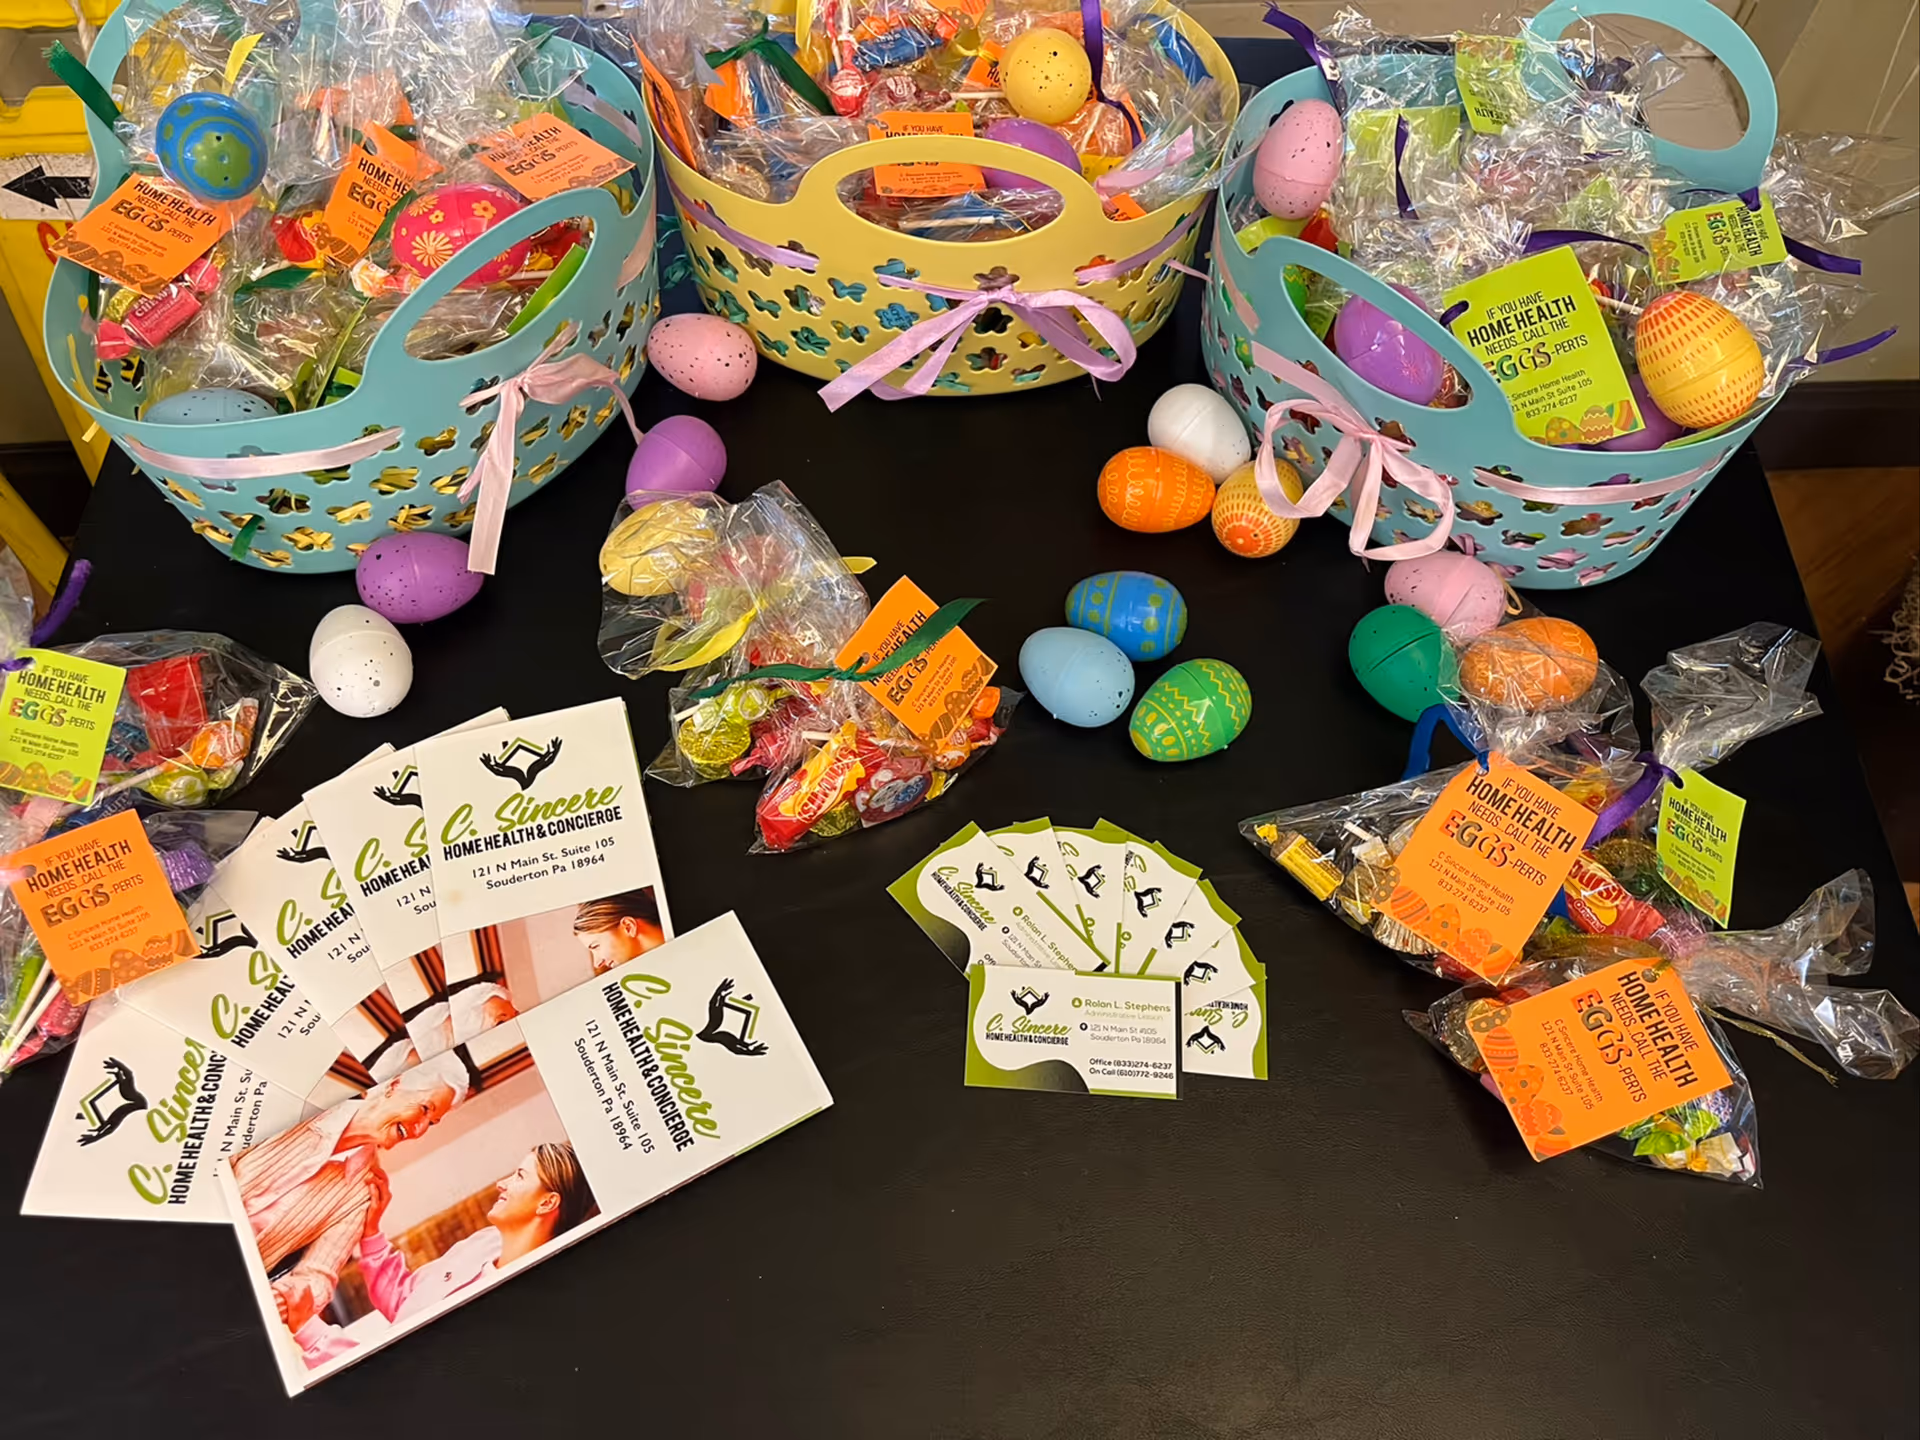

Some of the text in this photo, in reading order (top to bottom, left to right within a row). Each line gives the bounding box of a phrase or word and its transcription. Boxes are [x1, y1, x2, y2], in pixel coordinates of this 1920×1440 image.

[926, 125, 944, 133] HAVE
[358, 157, 394, 187] HOME
[170, 197, 217, 227] HEALTH
[1466, 295, 1577, 347] HOME HEALTH
[1486, 291, 1545, 320] IF YOU HAVE
[1549, 317, 1570, 333] THE
[1512, 369, 1586, 401] Sincere Home Health
[1529, 378, 1593, 408] Main St Suite 105
[1526, 394, 1578, 419] 833-274-6237
[878, 619, 906, 653] YOU HAVE
[17, 671, 107, 704] HOME HEALTH
[42, 665, 90, 684] IF YOU HAVE
[77, 700, 92, 712] THE
[440, 803, 479, 845] C.
[494, 785, 623, 833] Sincere
[1466, 775, 1578, 854] HOME HEALTH
[1501, 777, 1562, 820] IF YOU HAVE
[443, 837, 484, 861] HOME
[484, 822, 535, 852] HEALTH
[547, 806, 623, 837] CONCIERGE
[1669, 797, 1727, 843] HOME HEALTH
[25, 839, 132, 893] HOME HEALTH
[44, 838, 102, 868] IF YOU HAVE
[108, 859, 126, 874] THE
[354, 837, 391, 882] C.
[472, 836, 615, 879] 121 N Main St. Suite 105
[1530, 840, 1552, 859] THE
[360, 867, 402, 898] HOME
[486, 853, 606, 890] Souderton Pa 18964
[1428, 858, 1512, 916] 121 N Main St Suite 105
[1444, 854, 1515, 905] Sincere Home Health
[396, 892, 416, 908] 121
[419, 886, 431, 896] N
[953, 881, 997, 925] Sincere
[1437, 878, 1489, 915] 833-274-6237
[277, 899, 313, 946] C.
[286, 923, 328, 959] HOME
[327, 943, 347, 960] 121
[348, 933, 361, 944] N
[1021, 915, 1041, 937] Rolan
[1048, 942, 1078, 973] Stephen
[211, 993, 251, 1039] C.
[277, 1006, 308, 1039] 121 N
[1085, 999, 1171, 1012] Rolan Stephens
[1654, 989, 1700, 1052] IF YOU HAVE
[231, 1008, 271, 1049] HOME
[985, 1032, 1069, 1046] HOME HEALTH CONCIERGE
[986, 1013, 1072, 1036] C. Sincere
[1090, 1033, 1129, 1042] Souderton
[1617, 971, 1699, 1088] HOME HEALTH
[601, 981, 695, 1152] HOME HEALTH CONCIERGE
[619, 973, 721, 1140] C. Sincere
[1089, 1058, 1172, 1070] Office (833)274-6237
[1117, 1069, 1174, 1079] (610)772-9246
[1539, 1042, 1573, 1096] 833-274-6237
[1541, 1020, 1595, 1110] 121 N Main St Suite 105
[1557, 1024, 1603, 1103] Sincere Home Health
[1647, 1057, 1668, 1082] THE
[236, 1087, 249, 1104] St.
[254, 1080, 268, 1095] Pa
[574, 1038, 633, 1151] Souderton Pa 18964
[585, 1019, 656, 1154] 121 N Main St. Suite 105
[226, 1110, 243, 1137] Main
[167, 1102, 212, 1205] HOME HEALTH
[220, 1142, 233, 1152] N
[127, 1163, 173, 1205] C.
